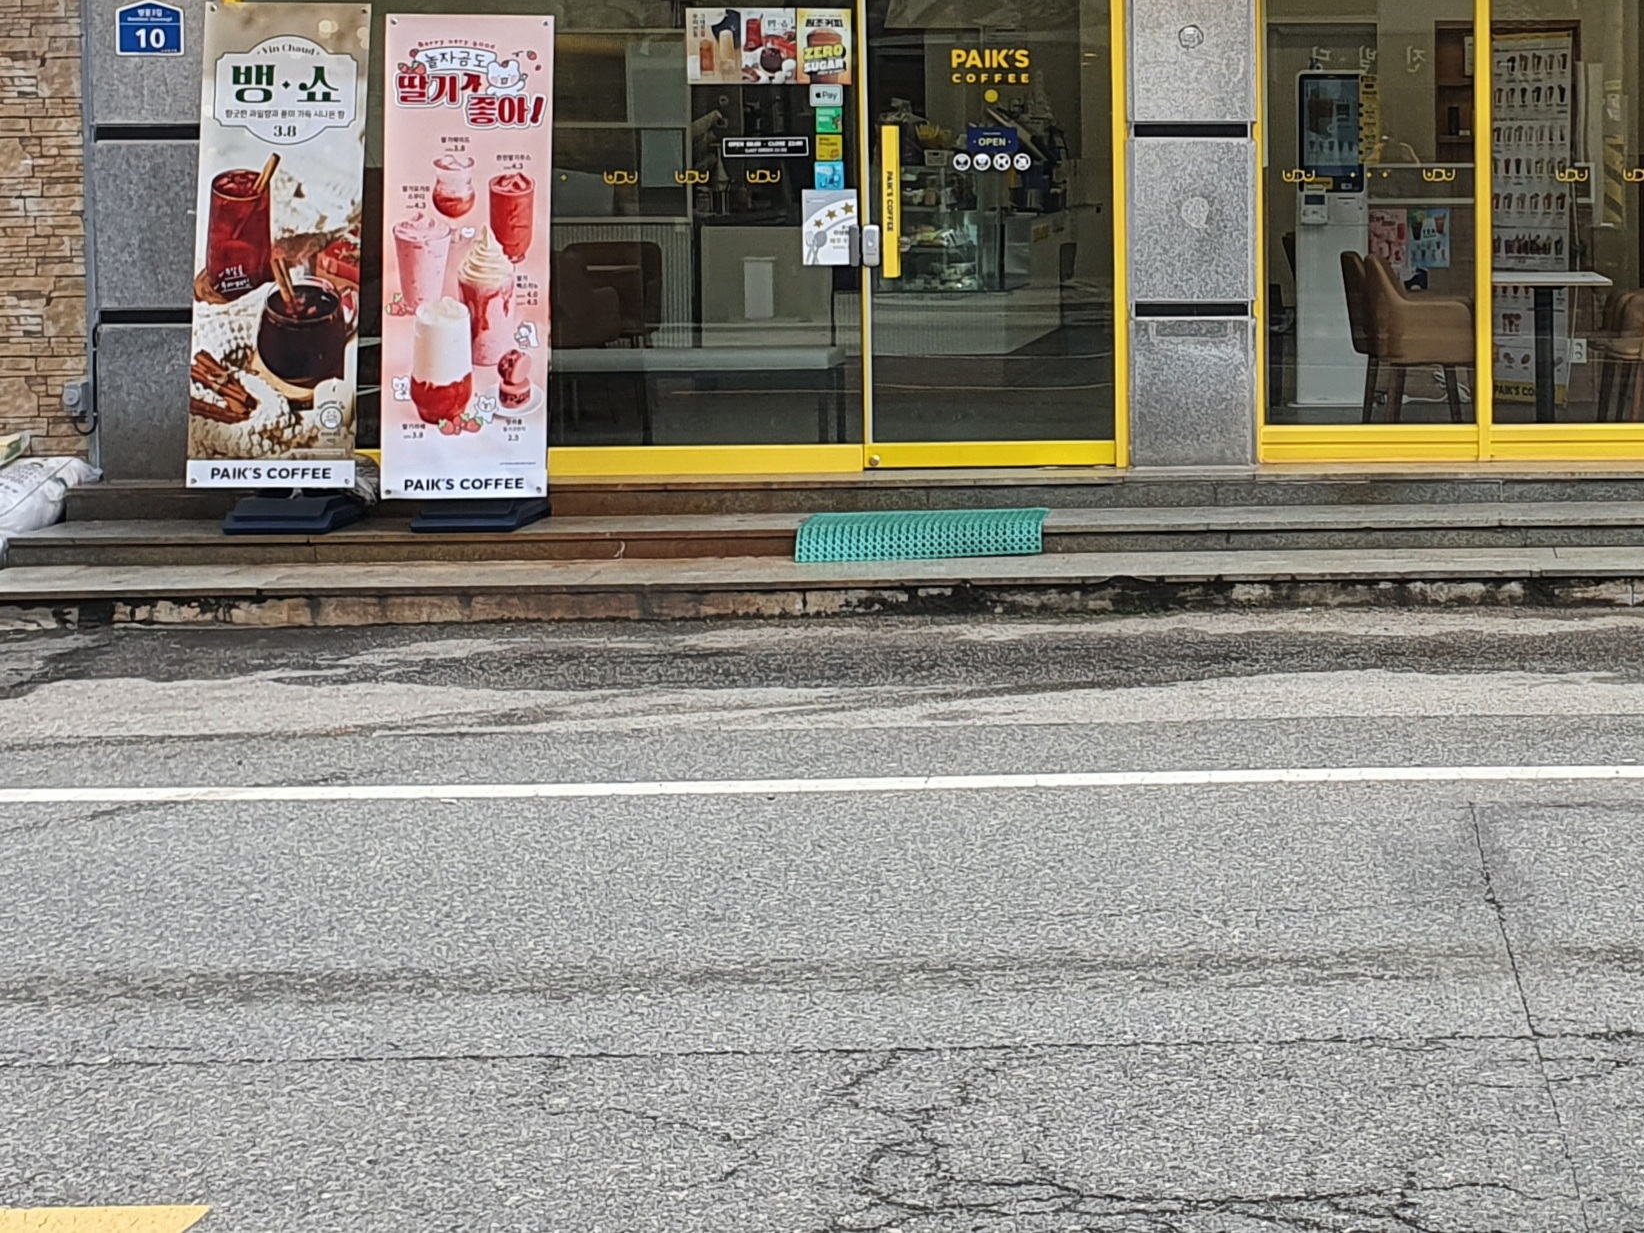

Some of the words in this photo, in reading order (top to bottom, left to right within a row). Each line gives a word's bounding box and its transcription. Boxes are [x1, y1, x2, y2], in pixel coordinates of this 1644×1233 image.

[135, 28, 166, 49] 10
[281, 43, 316, 56] Chaud
[803, 44, 844, 60] ZERO
[424, 50, 487, 69] 놀자곰도
[803, 58, 845, 73] SUGAR
[951, 49, 1030, 69] PAIK'S
[951, 73, 1030, 83] COFFEE
[398, 72, 482, 104] 딸기가
[822, 91, 838, 101] Pay
[468, 96, 544, 125] 좋아!
[273, 125, 297, 137] 3.8
[978, 137, 1006, 146] OPEN
[210, 467, 262, 480] PAIK'S
[266, 467, 332, 480] COFFEE
[404, 478, 455, 491] PAIK'S
[459, 477, 525, 491] COFFEE
